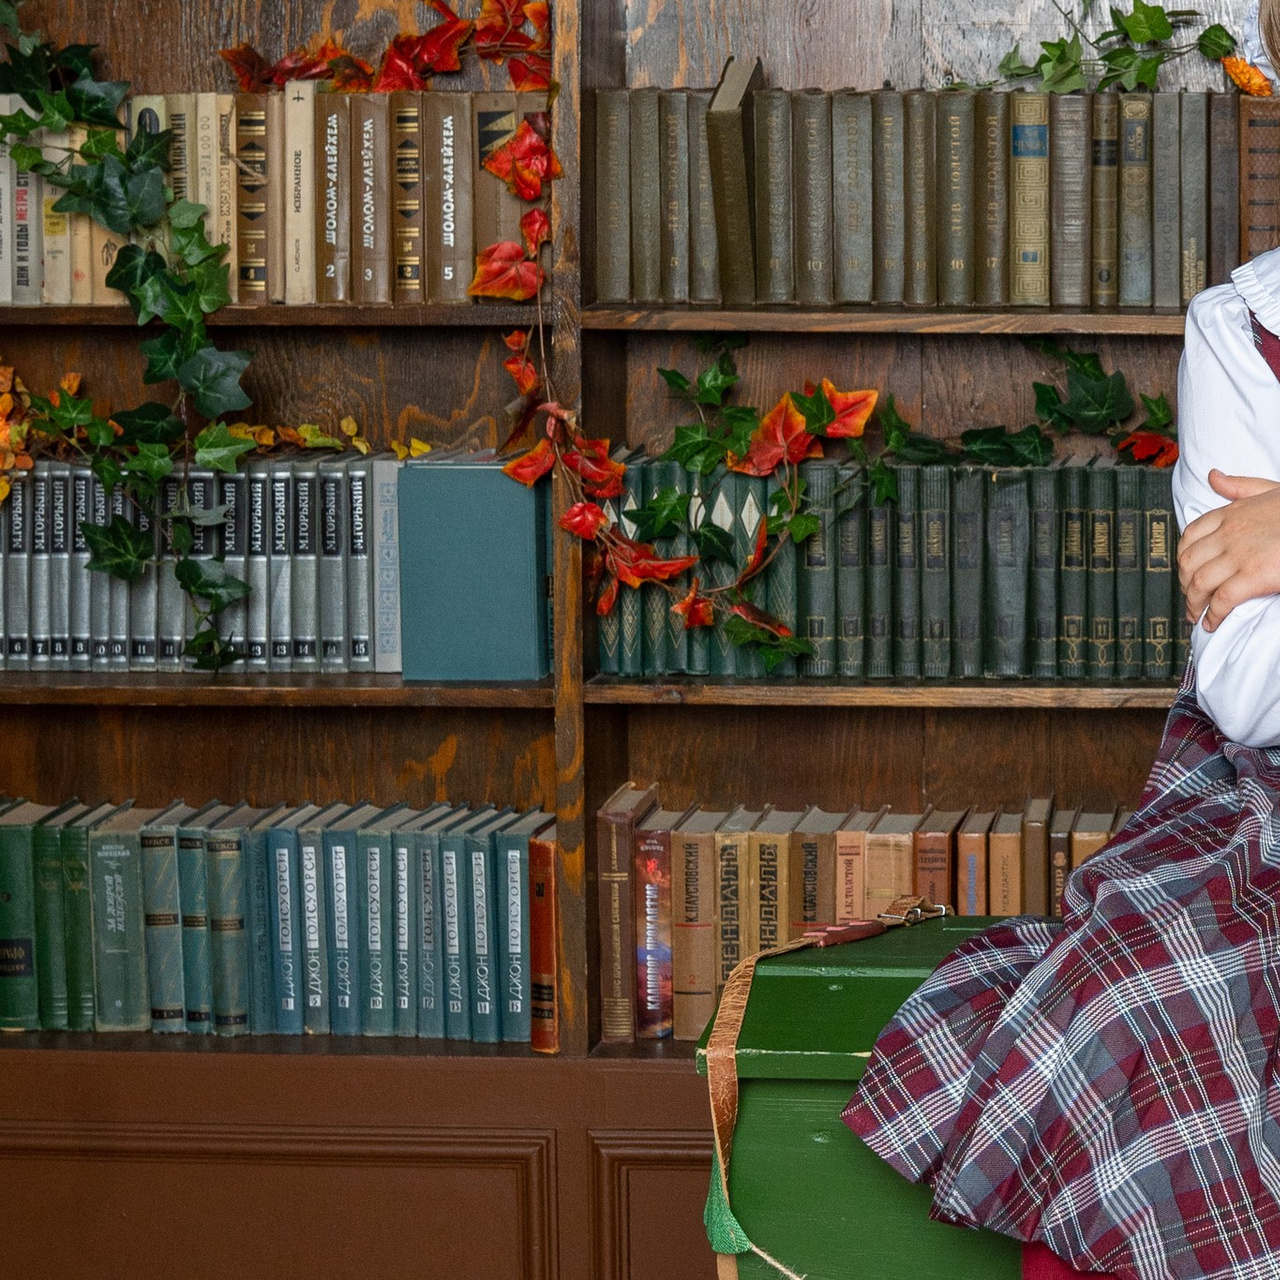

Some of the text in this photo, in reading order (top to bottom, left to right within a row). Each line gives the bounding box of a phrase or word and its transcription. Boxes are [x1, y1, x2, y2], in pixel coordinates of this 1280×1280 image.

[293, 149, 302, 214] ИЗБРАННОЕ
[325, 113, 338, 246] ШОЛОМ-АЛЕЙХЕМ
[363, 118, 374, 250] ШОЛОМ-АЛЕЙХЕМ
[442, 114, 454, 247] ШОЛОМ-АЛЕЙХЕМ
[16, 224, 30, 253] ГОДЫ
[16, 265, 30, 287] ДНИ
[325, 264, 335, 278] 2
[363, 266, 373, 281] 3
[443, 266, 454, 280] 5
[14, 642, 22, 653] 6
[36, 643, 43, 654] 7
[55, 642, 62, 653] 8
[276, 643, 287, 654] 13
[354, 642, 365, 654] 15
[278, 850, 295, 997] ДЖОН ГОЛСУОРСИ
[305, 849, 324, 994] ДЖОН ГОЛСУОРСИ
[334, 849, 351, 995] ДЖОН ГОЛСУОРСИ
[369, 849, 384, 996] ДЖОН ГОЛСУОРСИ
[445, 854, 463, 1000] ДЖОН ГОЛСУОРСИ
[509, 955, 522, 999] ДЖОН
[688, 975, 697, 986] 2
